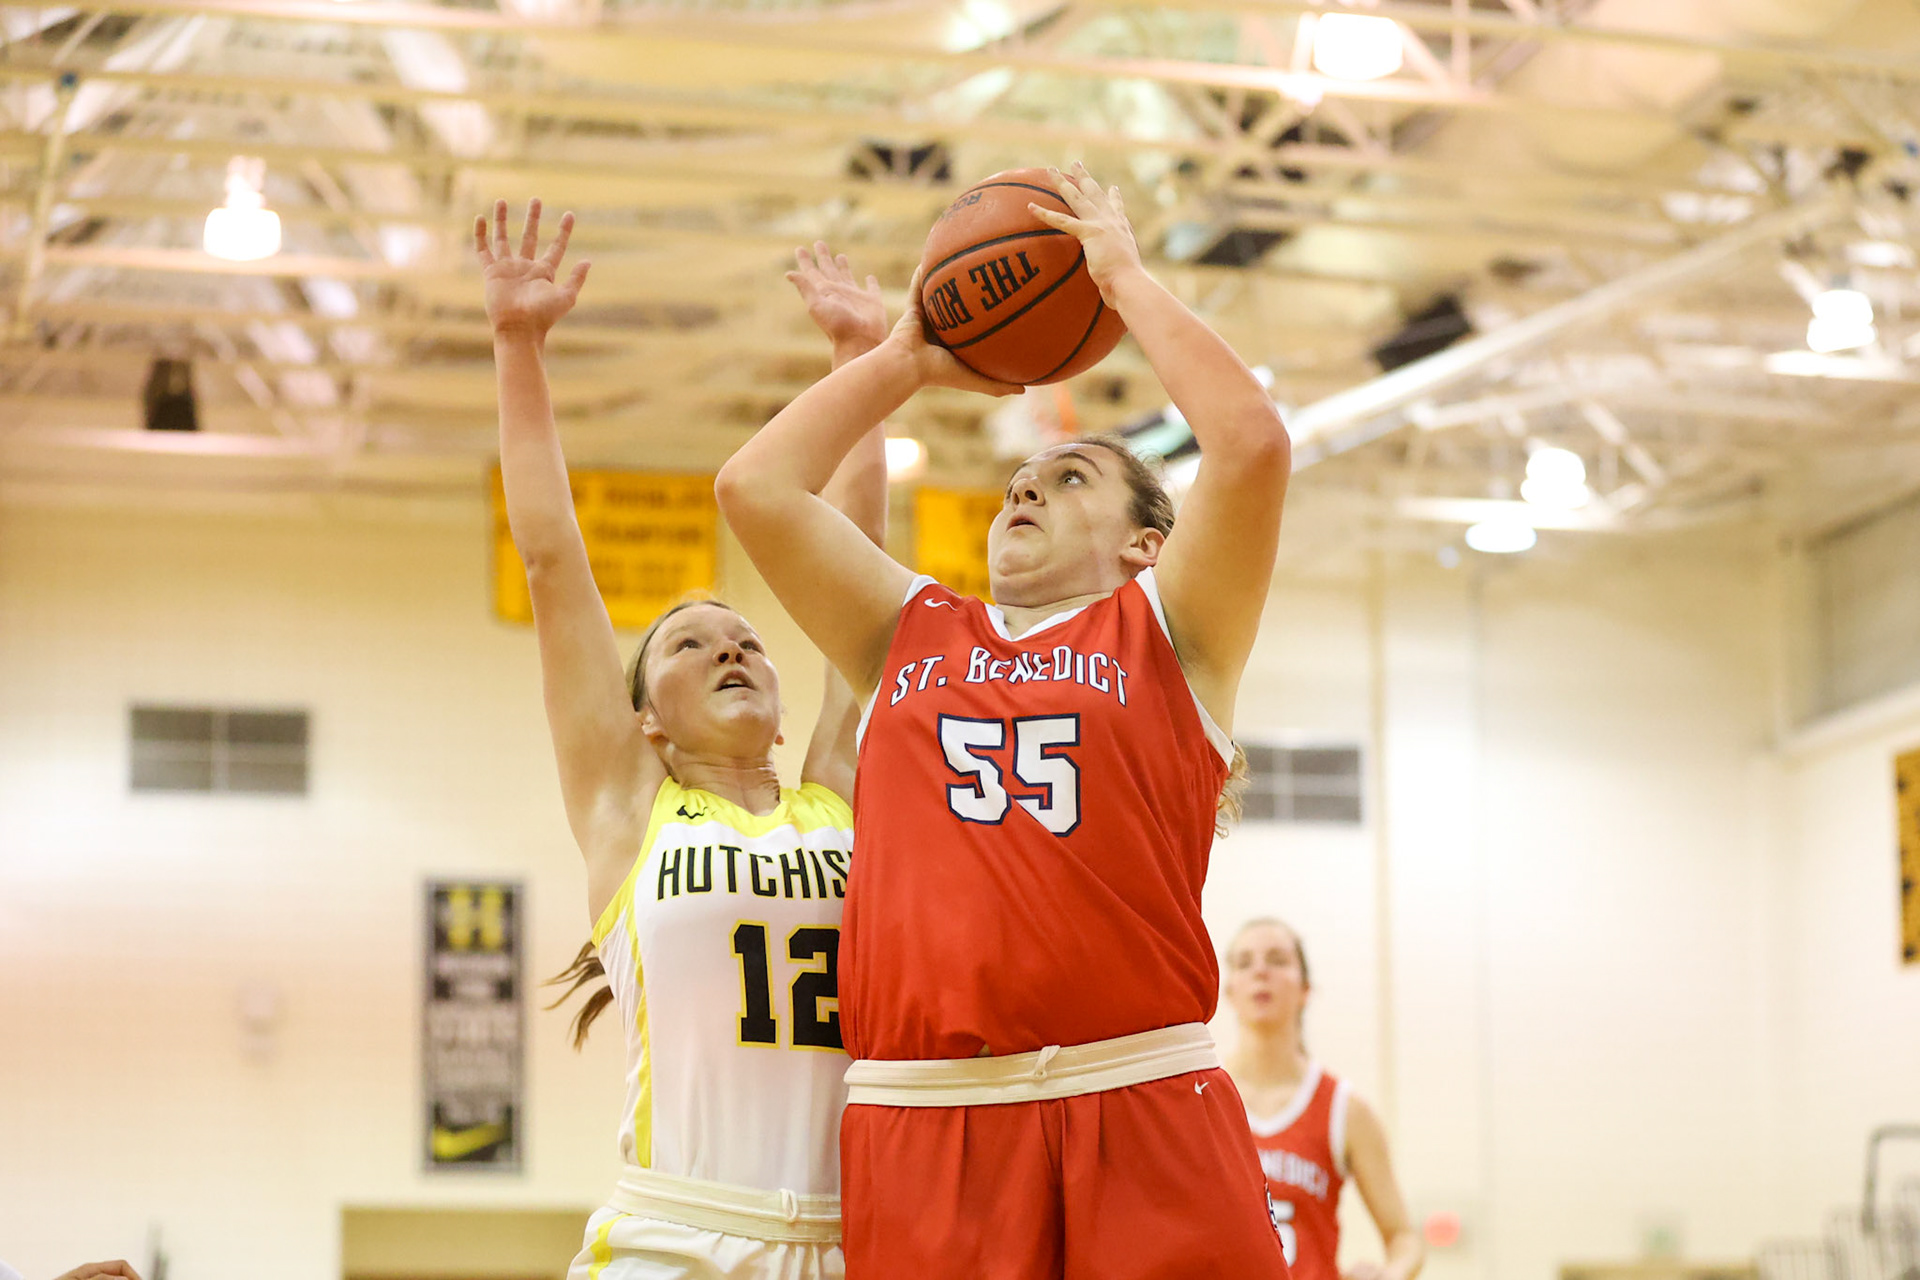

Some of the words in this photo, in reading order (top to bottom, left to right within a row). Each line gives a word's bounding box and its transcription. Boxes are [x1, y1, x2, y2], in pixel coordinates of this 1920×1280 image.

[968, 251, 1041, 312] THE
[890, 655, 948, 707] ST.
[964, 645, 1128, 707] BENEDICT
[937, 713, 1081, 837] 55
[657, 844, 852, 900] HUTCHIS
[728, 919, 847, 1053] 12
